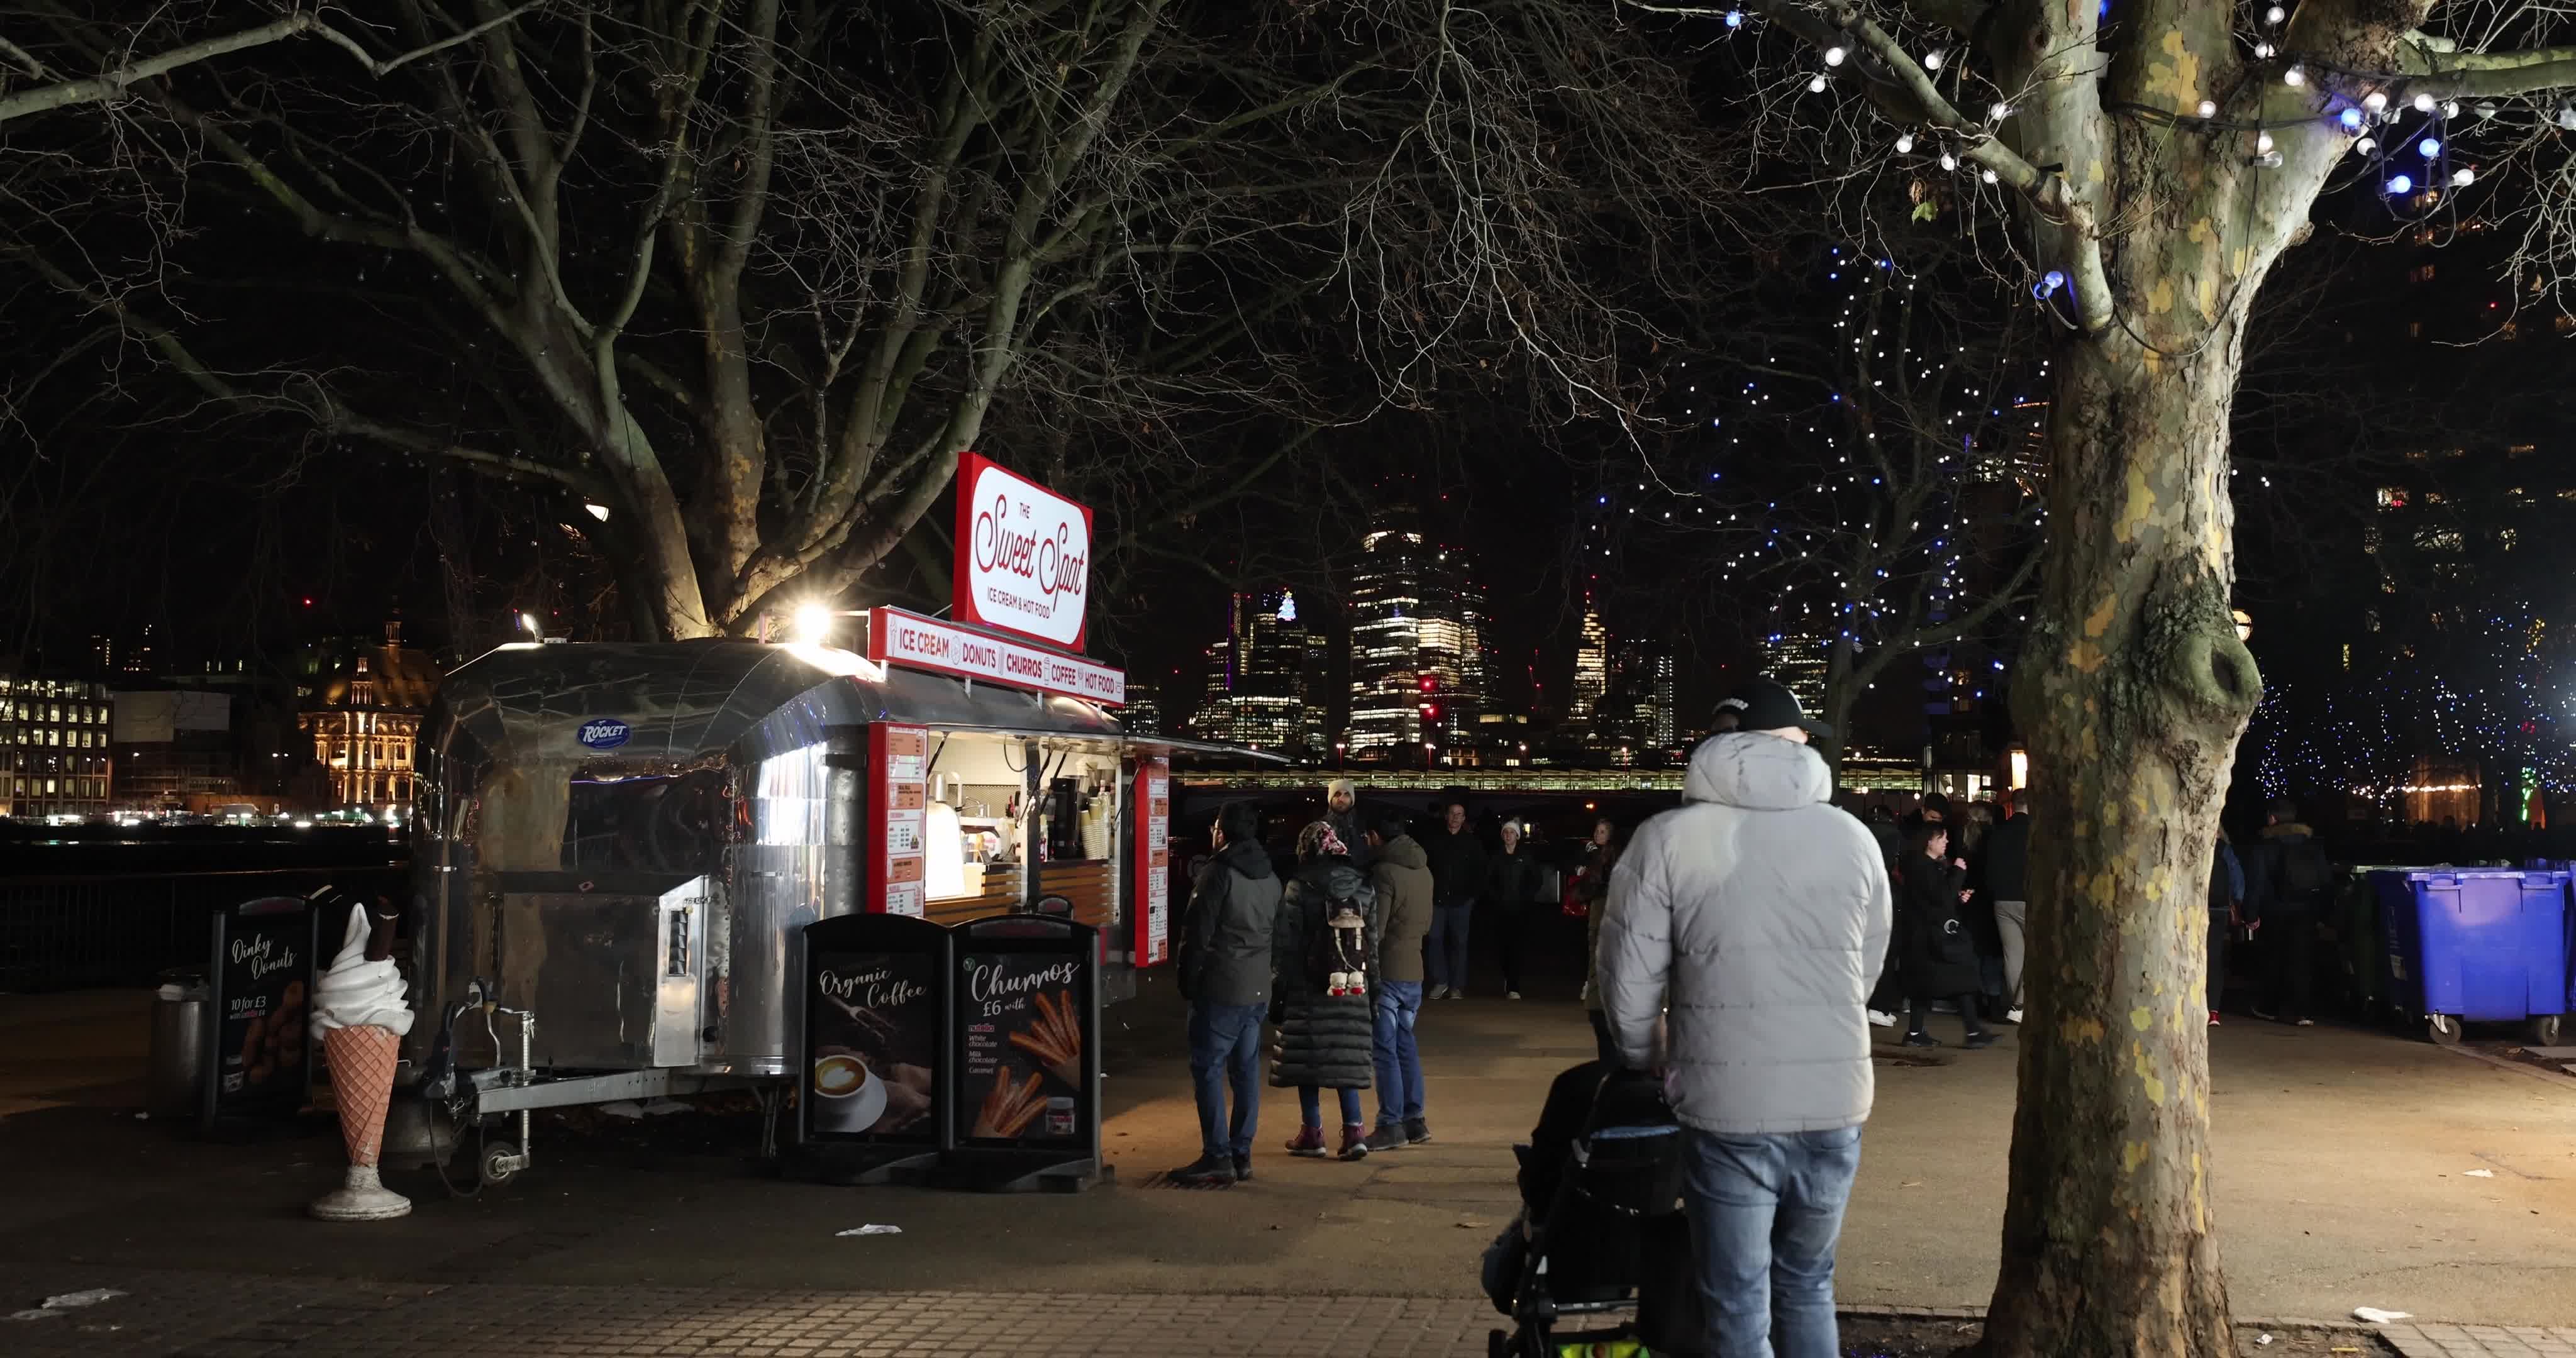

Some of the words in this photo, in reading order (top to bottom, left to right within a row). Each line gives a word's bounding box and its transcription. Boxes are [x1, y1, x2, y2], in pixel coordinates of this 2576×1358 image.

[1019, 502, 1031, 519] THE
[975, 494, 1037, 579] Sweet
[1039, 522, 1085, 613] Spot
[987, 586, 997, 602] ICE
[998, 590, 1018, 610] CREAM
[1018, 599, 1023, 611] &
[1023, 599, 1035, 614] HOT
[1035, 603, 1050, 619] FOOD
[899, 629, 916, 650] ICE
[917, 632, 949, 660] CREAM
[962, 643, 996, 668] DONUTS
[1006, 653, 1043, 678] CHURROS
[1051, 663, 1076, 686] COFFEE
[1085, 673, 1097, 690] HOT
[1098, 676, 1114, 694] FOOD
[583, 726, 626, 742] ROCKET
[231, 932, 275, 964] Dinky
[252, 945, 297, 981] Donuts
[819, 966, 892, 999] Organic
[867, 979, 926, 1009] Coffee
[970, 961, 1081, 1002] Churros
[231, 998, 241, 1011] 10
[240, 996, 255, 1013] for
[254, 995, 267, 1008] £3
[982, 1000, 1002, 1017] £6
[1004, 996, 1026, 1011] with
